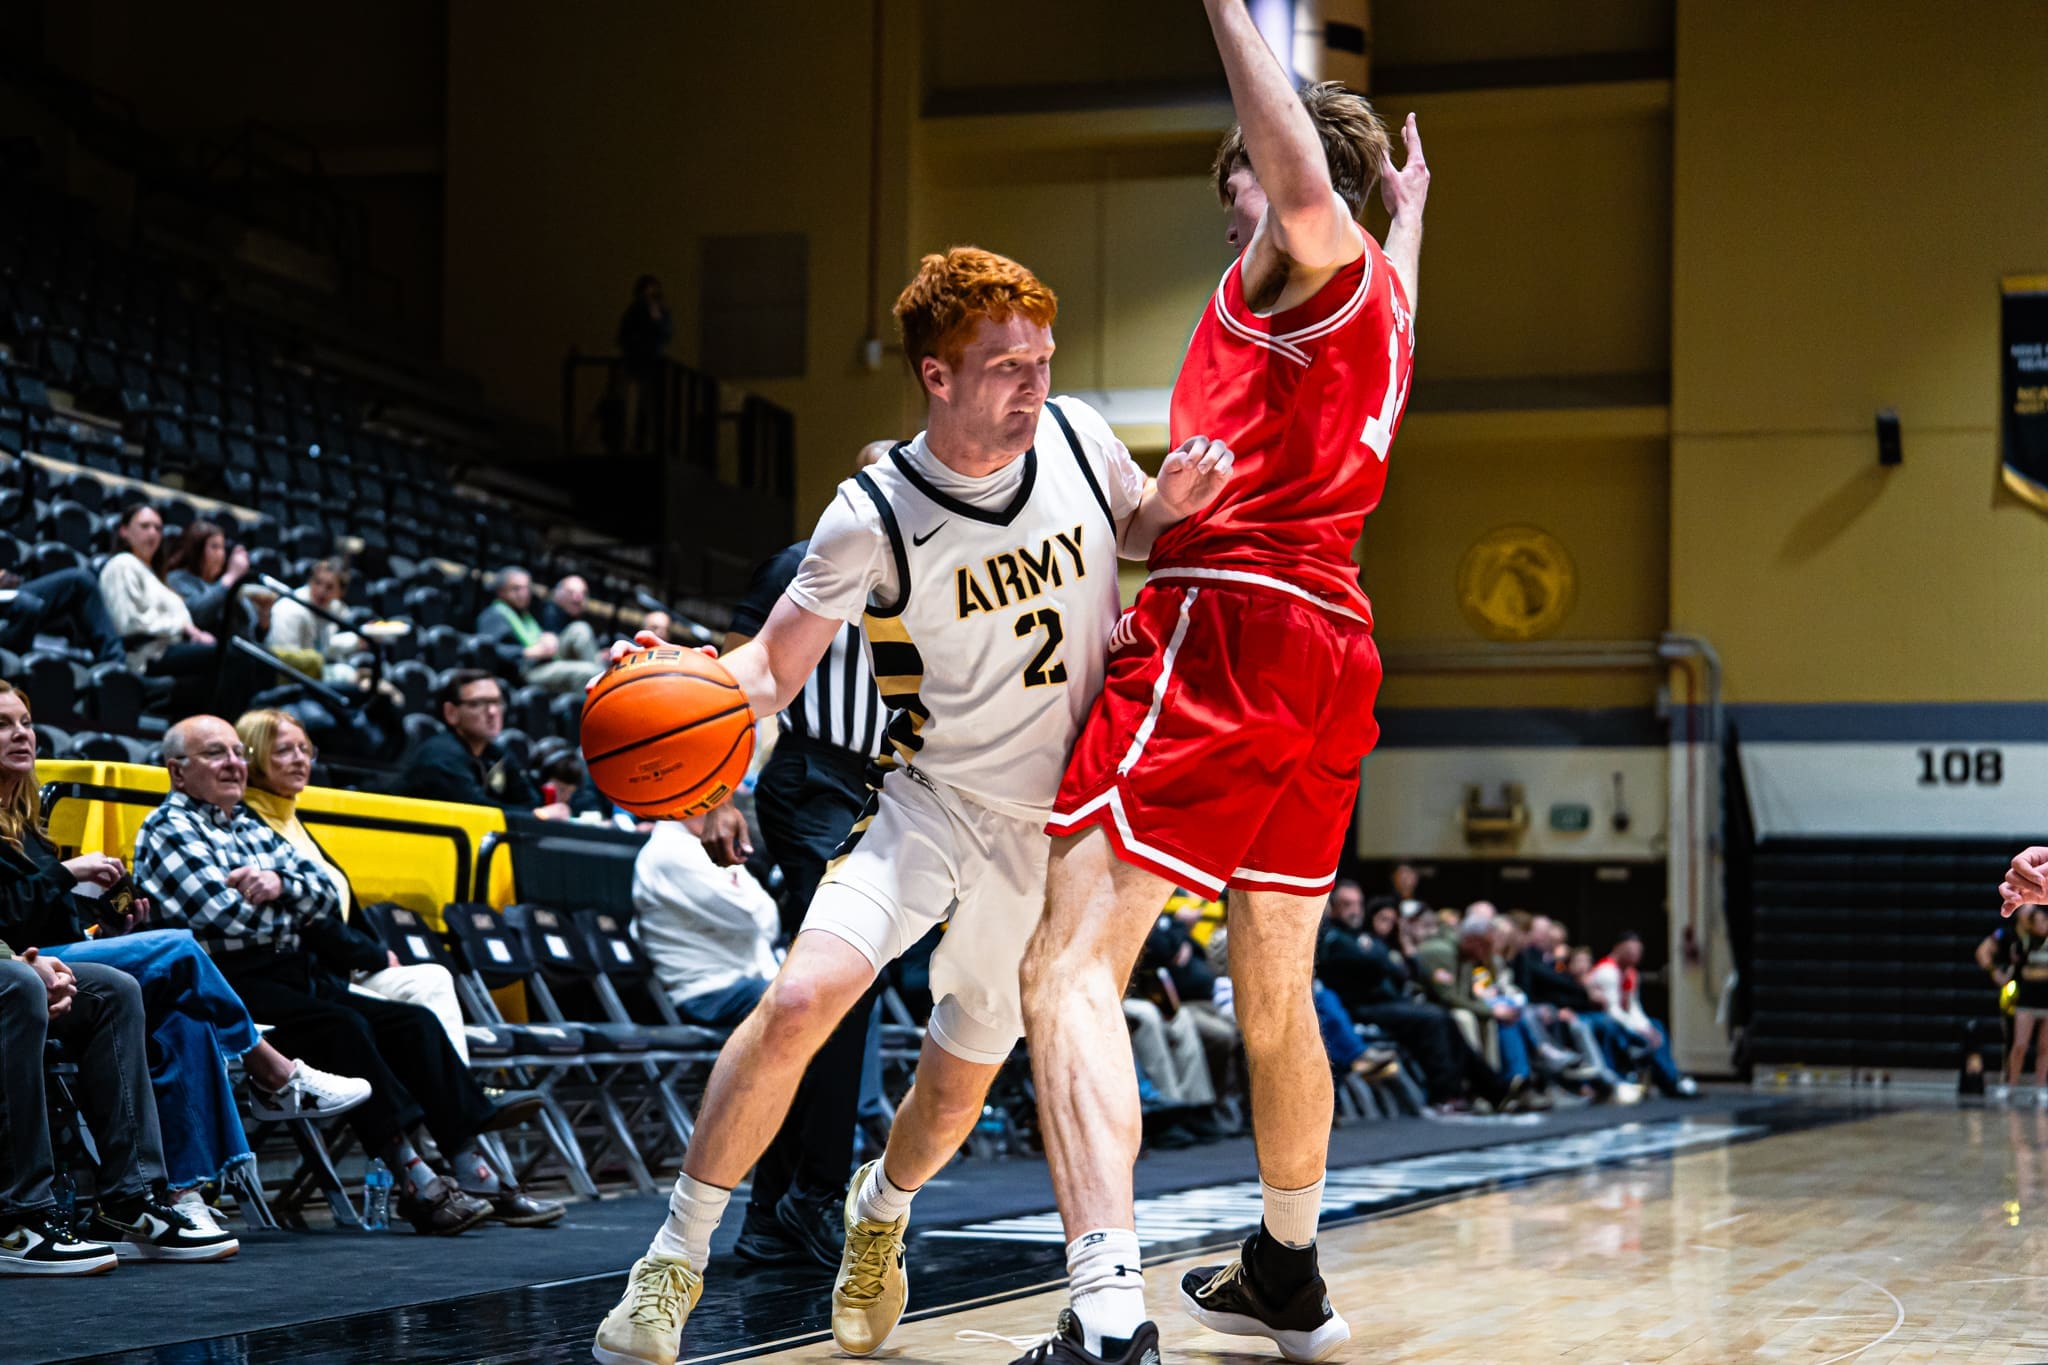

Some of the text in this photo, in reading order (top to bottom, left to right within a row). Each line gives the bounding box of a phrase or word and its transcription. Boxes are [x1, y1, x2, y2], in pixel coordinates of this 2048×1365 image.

[954, 524, 1087, 621] ARMY
[1013, 606, 1070, 689] 2
[1917, 747, 2004, 787] 108
